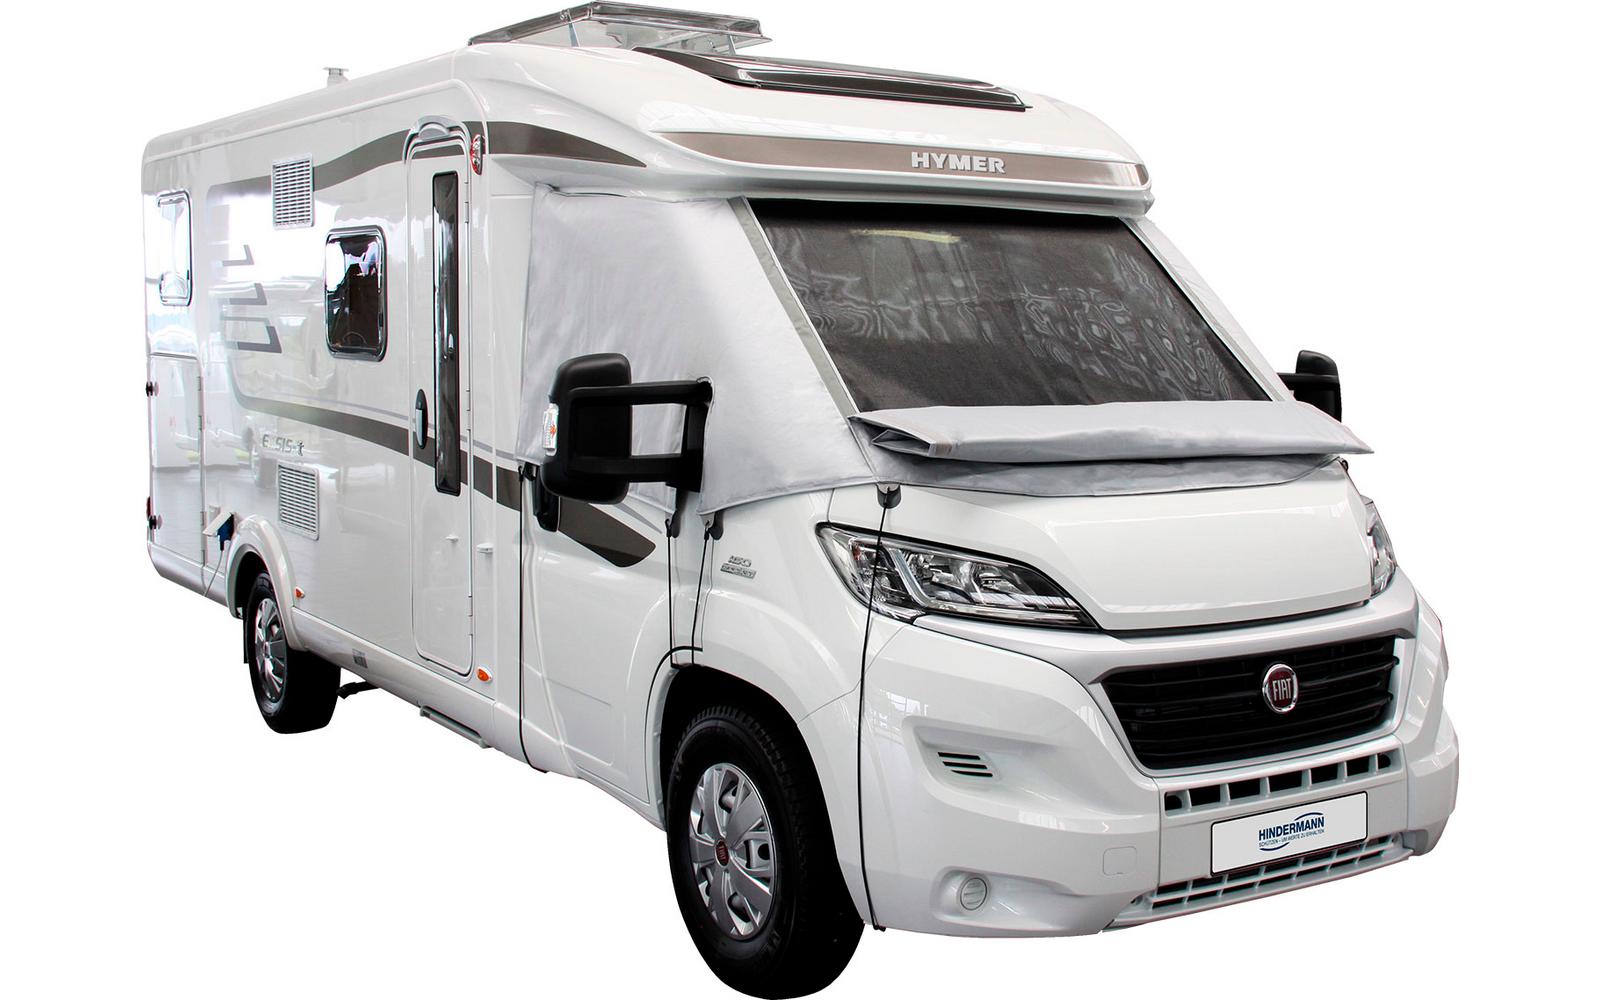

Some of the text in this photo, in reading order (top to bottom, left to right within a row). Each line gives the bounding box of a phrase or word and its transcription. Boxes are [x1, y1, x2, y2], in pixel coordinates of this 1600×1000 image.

[911, 151, 1006, 174] HYMER
[262, 433, 304, 456] ESIS-t
[1272, 678, 1291, 701] FIAT
[1258, 816, 1325, 841] HINDERMANN
